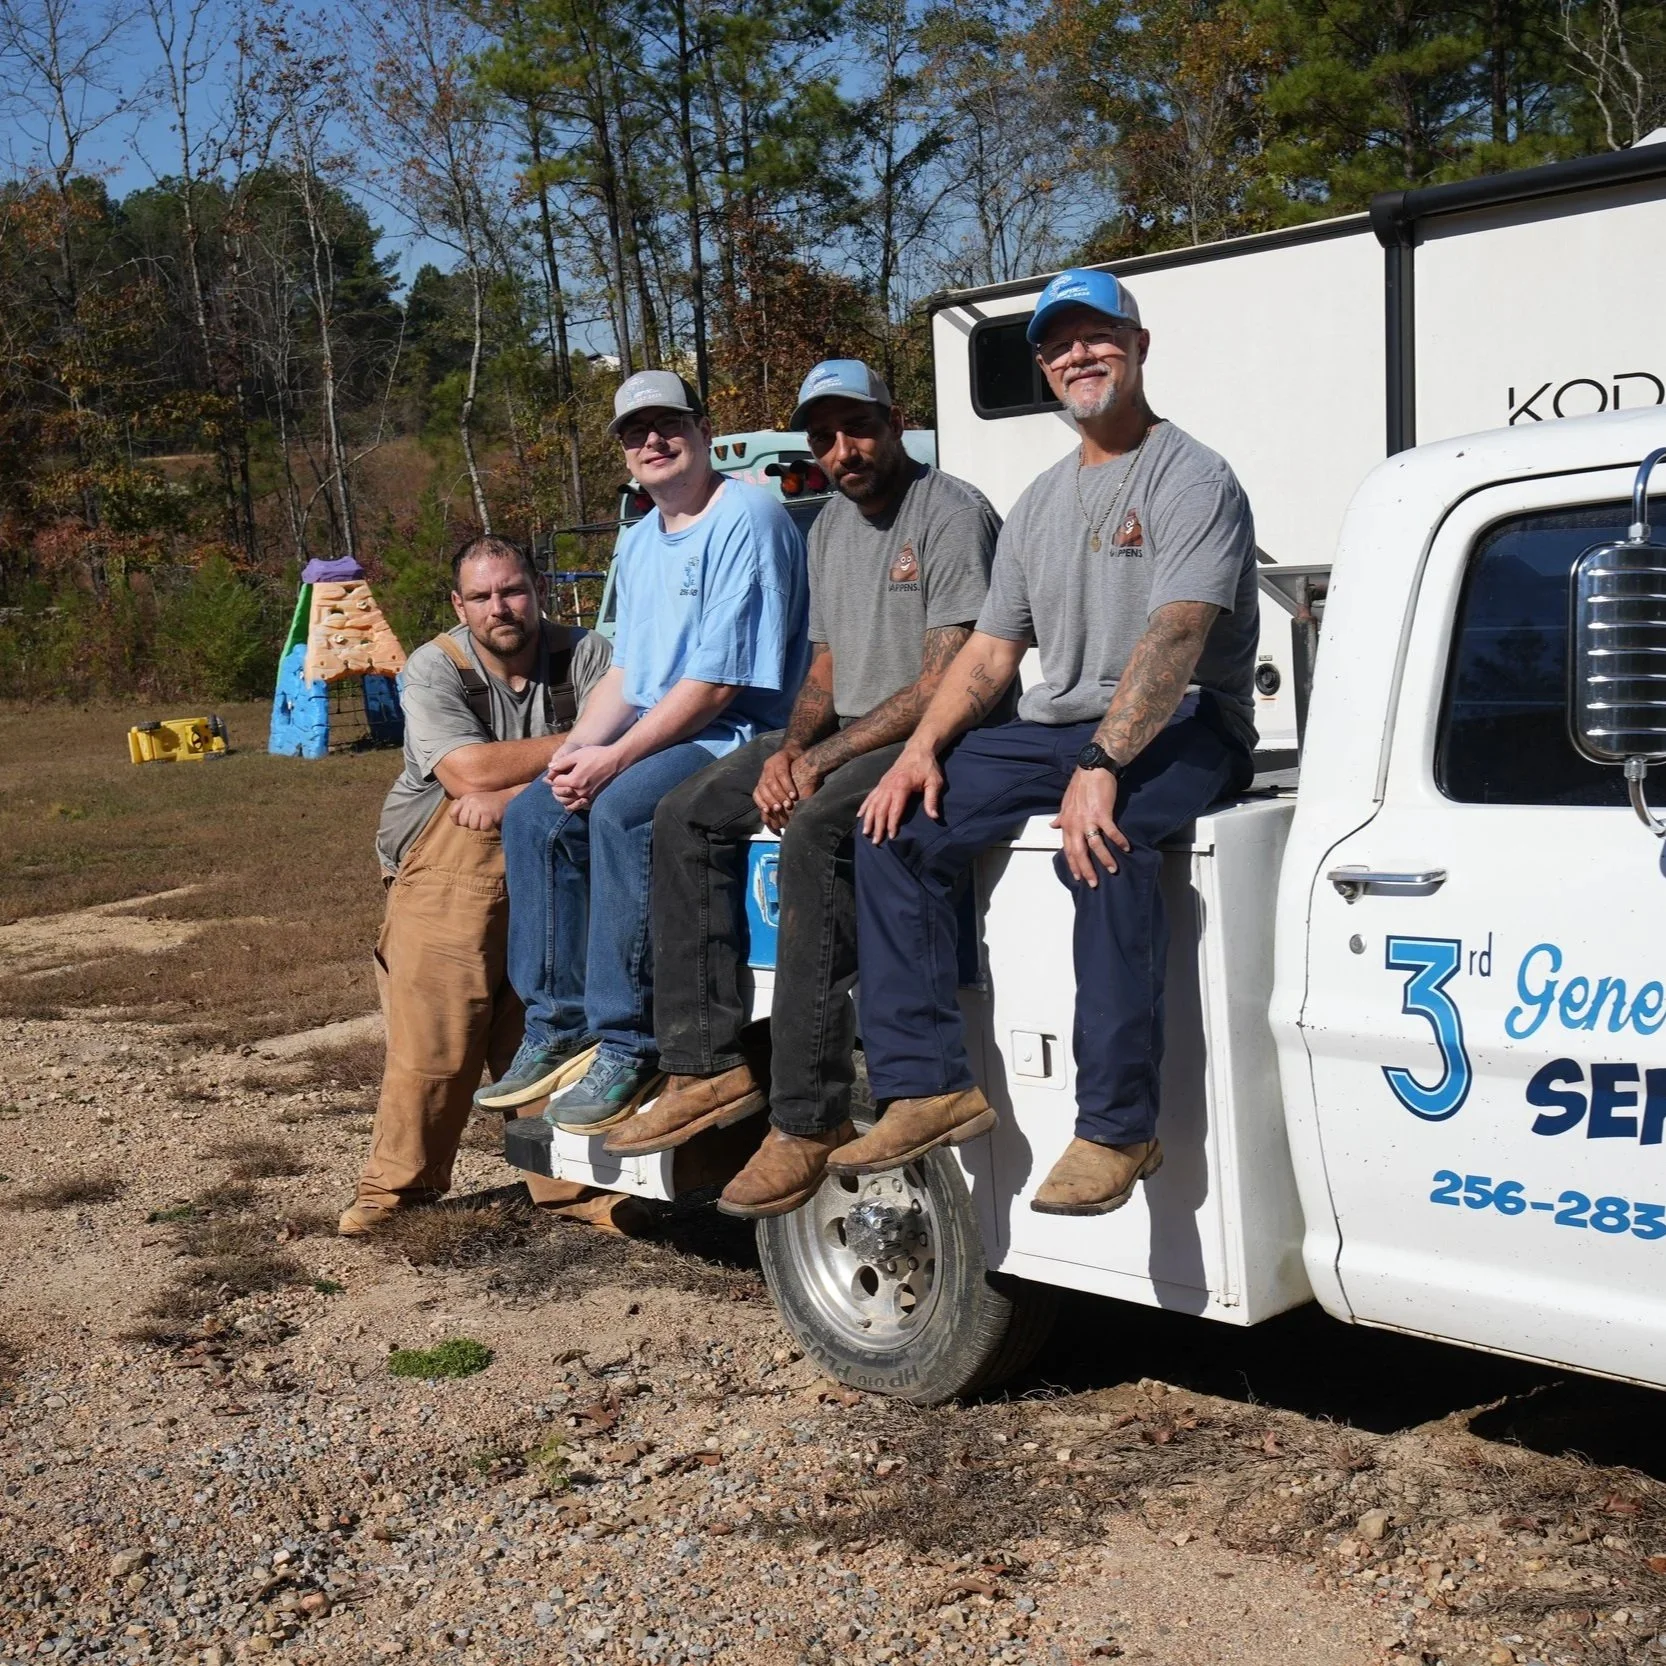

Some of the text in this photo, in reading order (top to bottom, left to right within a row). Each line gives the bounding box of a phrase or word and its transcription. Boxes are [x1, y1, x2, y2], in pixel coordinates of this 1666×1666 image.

[1508, 371, 1666, 427] KOD
[1504, 943, 1666, 1040] Gene
[1430, 1169, 1666, 1240] 256-283
[799, 1331, 852, 1380] PLUS
[889, 1364, 920, 1388] HP
